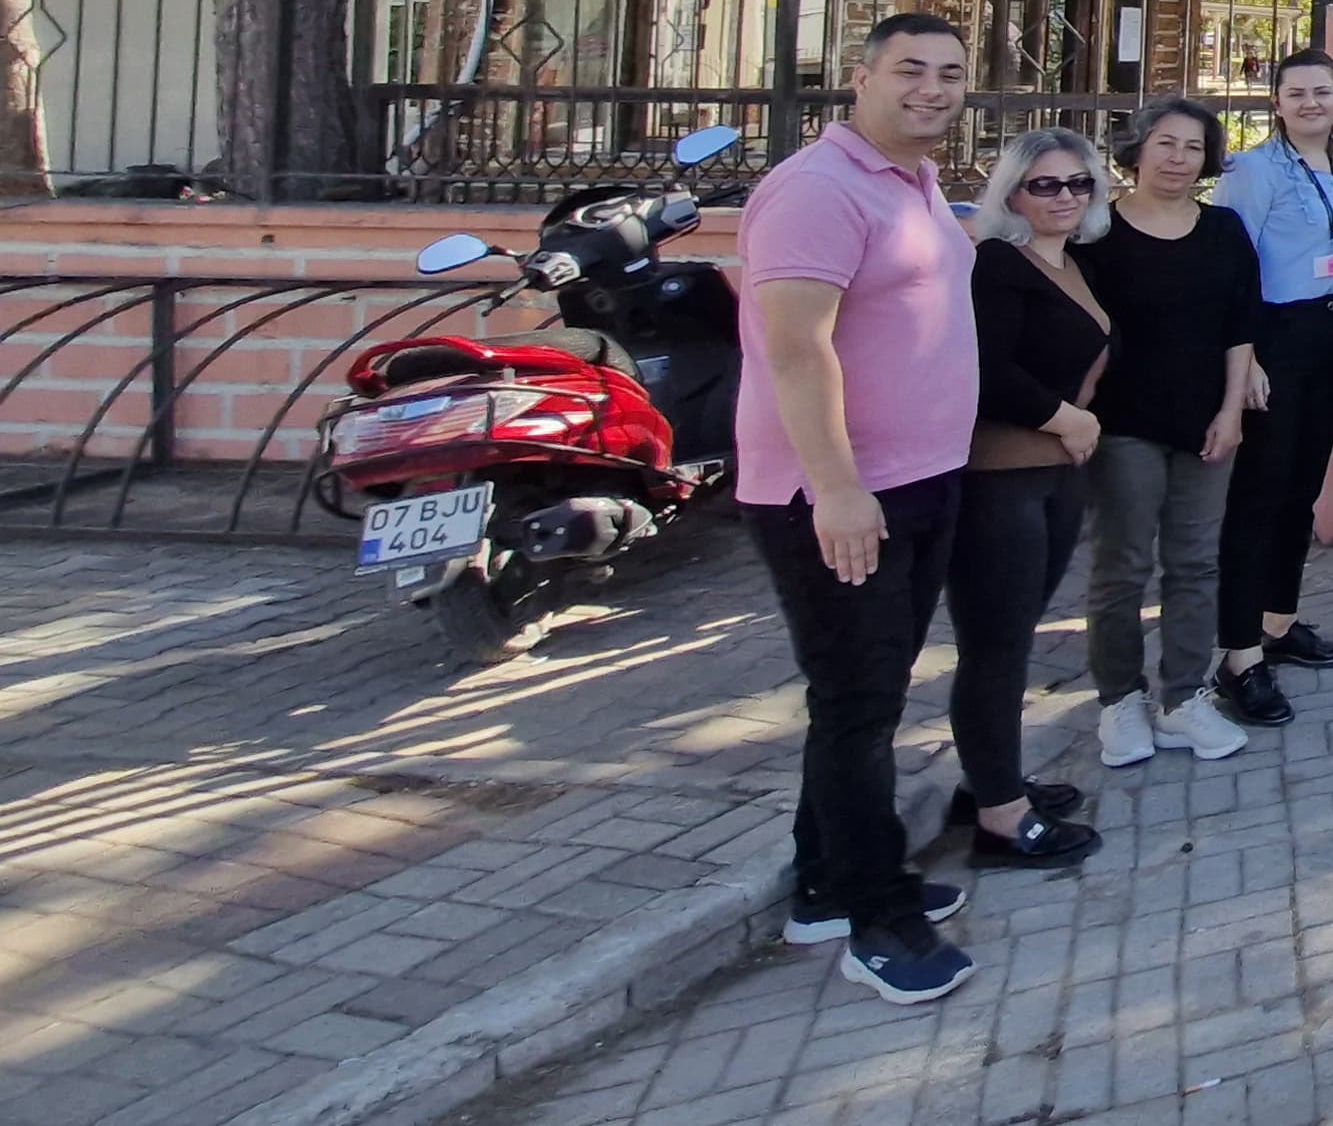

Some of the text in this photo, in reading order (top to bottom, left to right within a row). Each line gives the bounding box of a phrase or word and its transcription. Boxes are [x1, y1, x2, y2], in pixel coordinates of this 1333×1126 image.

[371, 491, 480, 531] 07 BJU
[388, 523, 448, 553] 404
